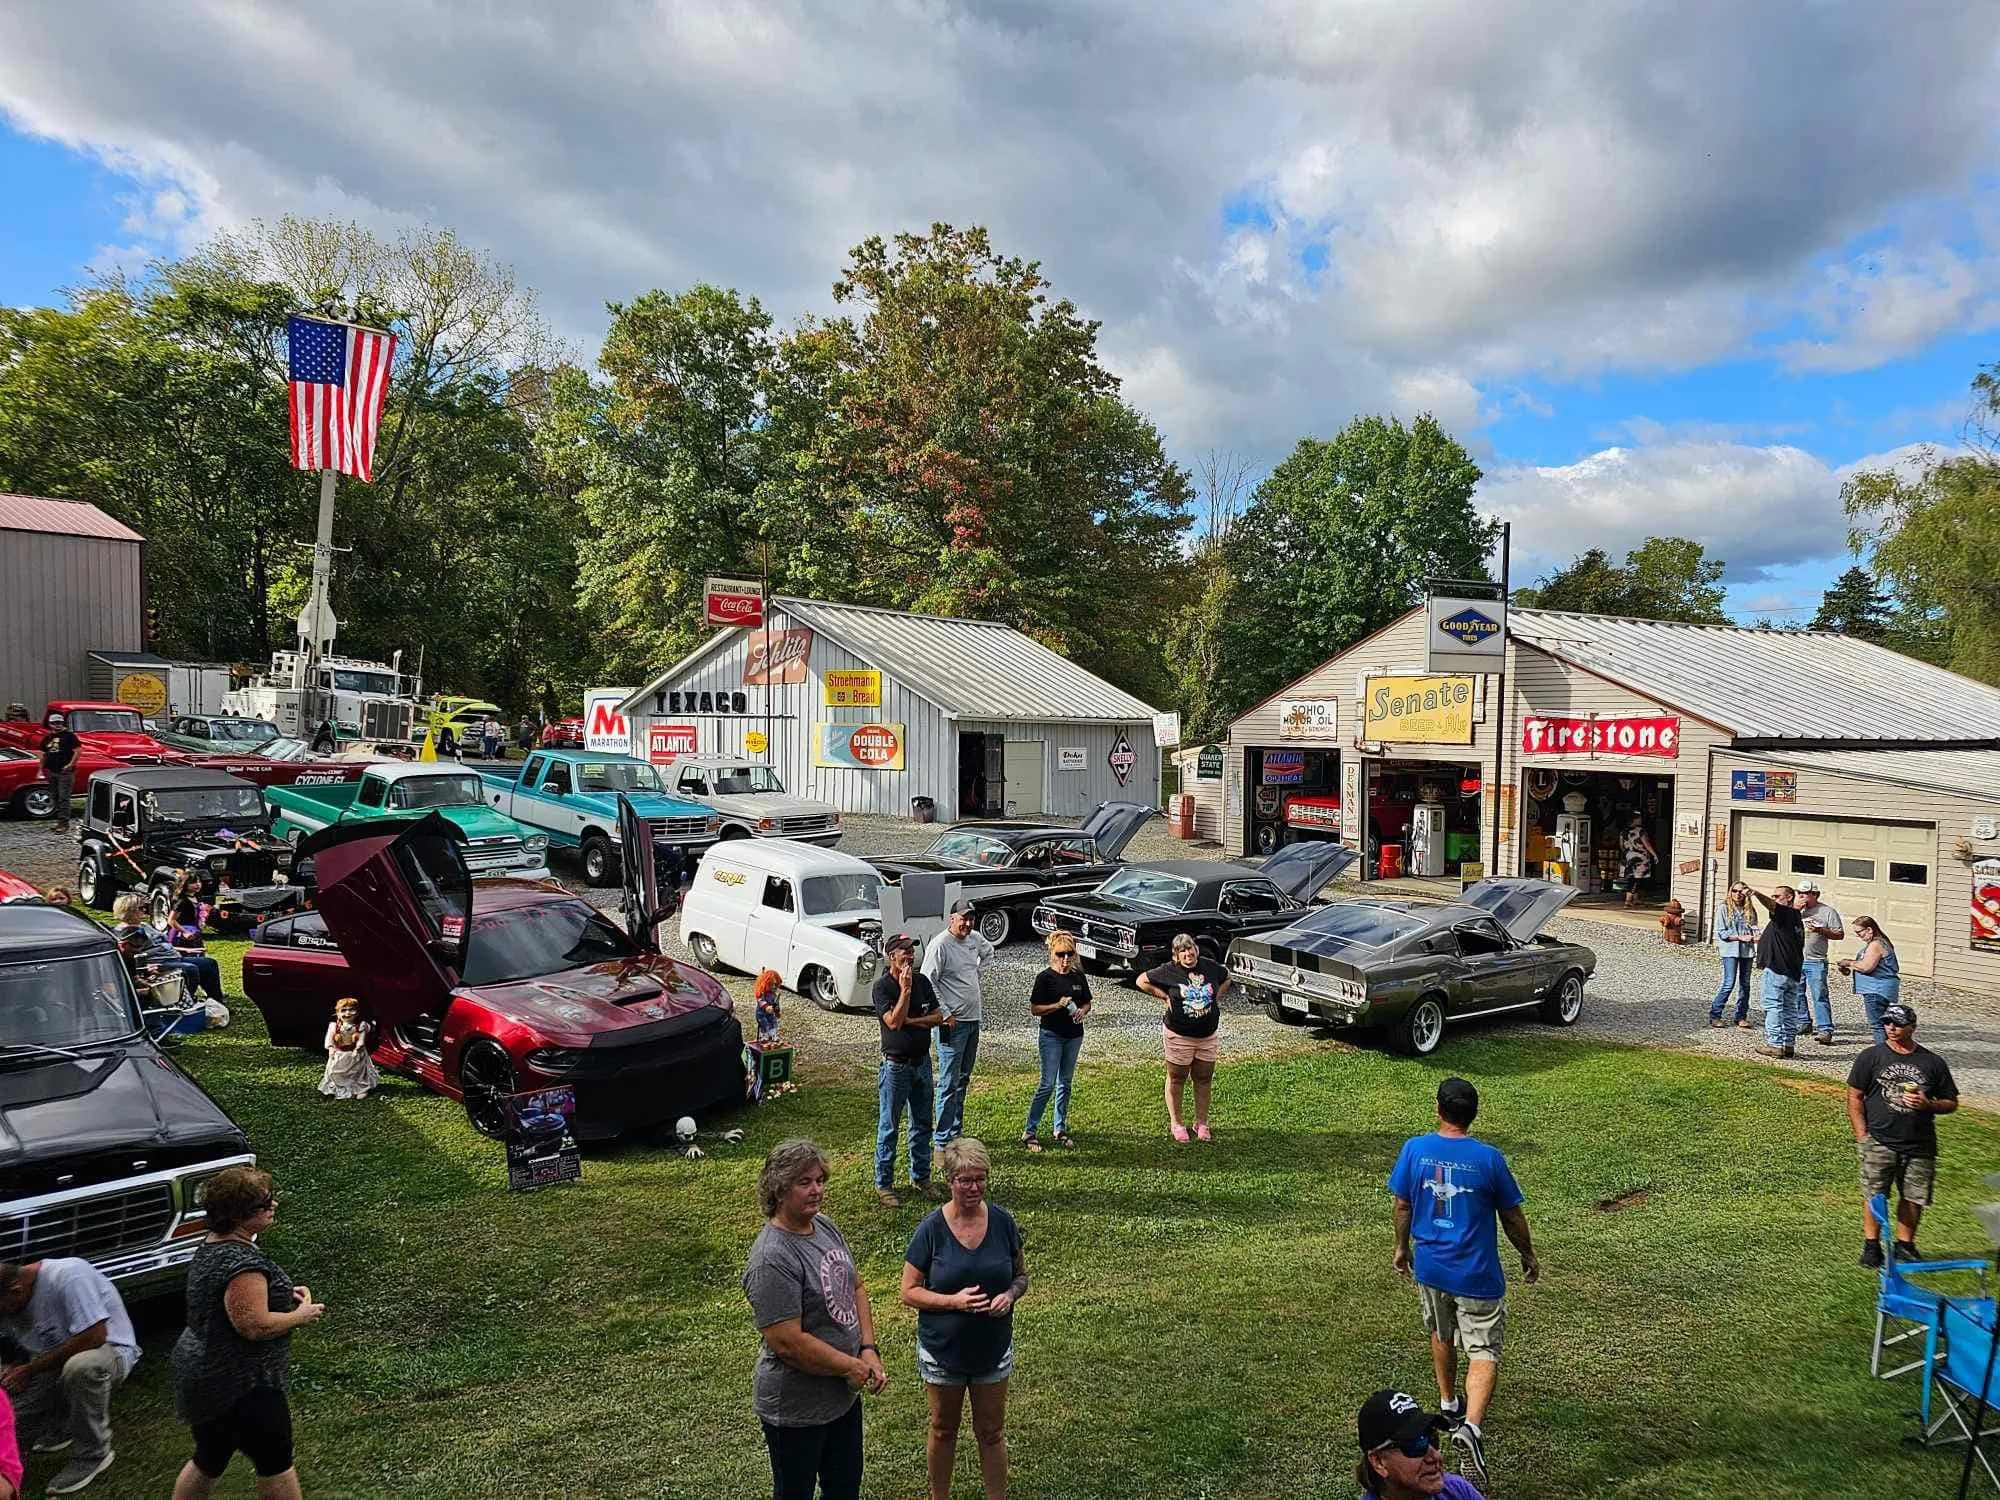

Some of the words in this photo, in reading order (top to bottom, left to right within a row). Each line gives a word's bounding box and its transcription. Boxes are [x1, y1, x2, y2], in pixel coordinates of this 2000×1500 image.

[828, 673, 875, 688] Stroehmann
[655, 691, 747, 714] TEXACO
[852, 689, 875, 703] Bread
[1368, 682, 1470, 722] Senate
[1291, 704, 1325, 716] SOHIO
[1317, 716, 1333, 725] OIL
[1399, 718, 1434, 732] BEER
[853, 735, 895, 748] DOUBLE
[1526, 720, 1676, 750] Firestone
[590, 738, 629, 749] MARATHON
[652, 736, 694, 753] ATLANTIC
[860, 748, 889, 761] COLA
[1113, 754, 1133, 764] SKELLY
[1200, 753, 1223, 761] QUAKER
[1200, 761, 1221, 769] STATE
[295, 775, 334, 786] CYCLONE
[769, 1058, 783, 1080] B
